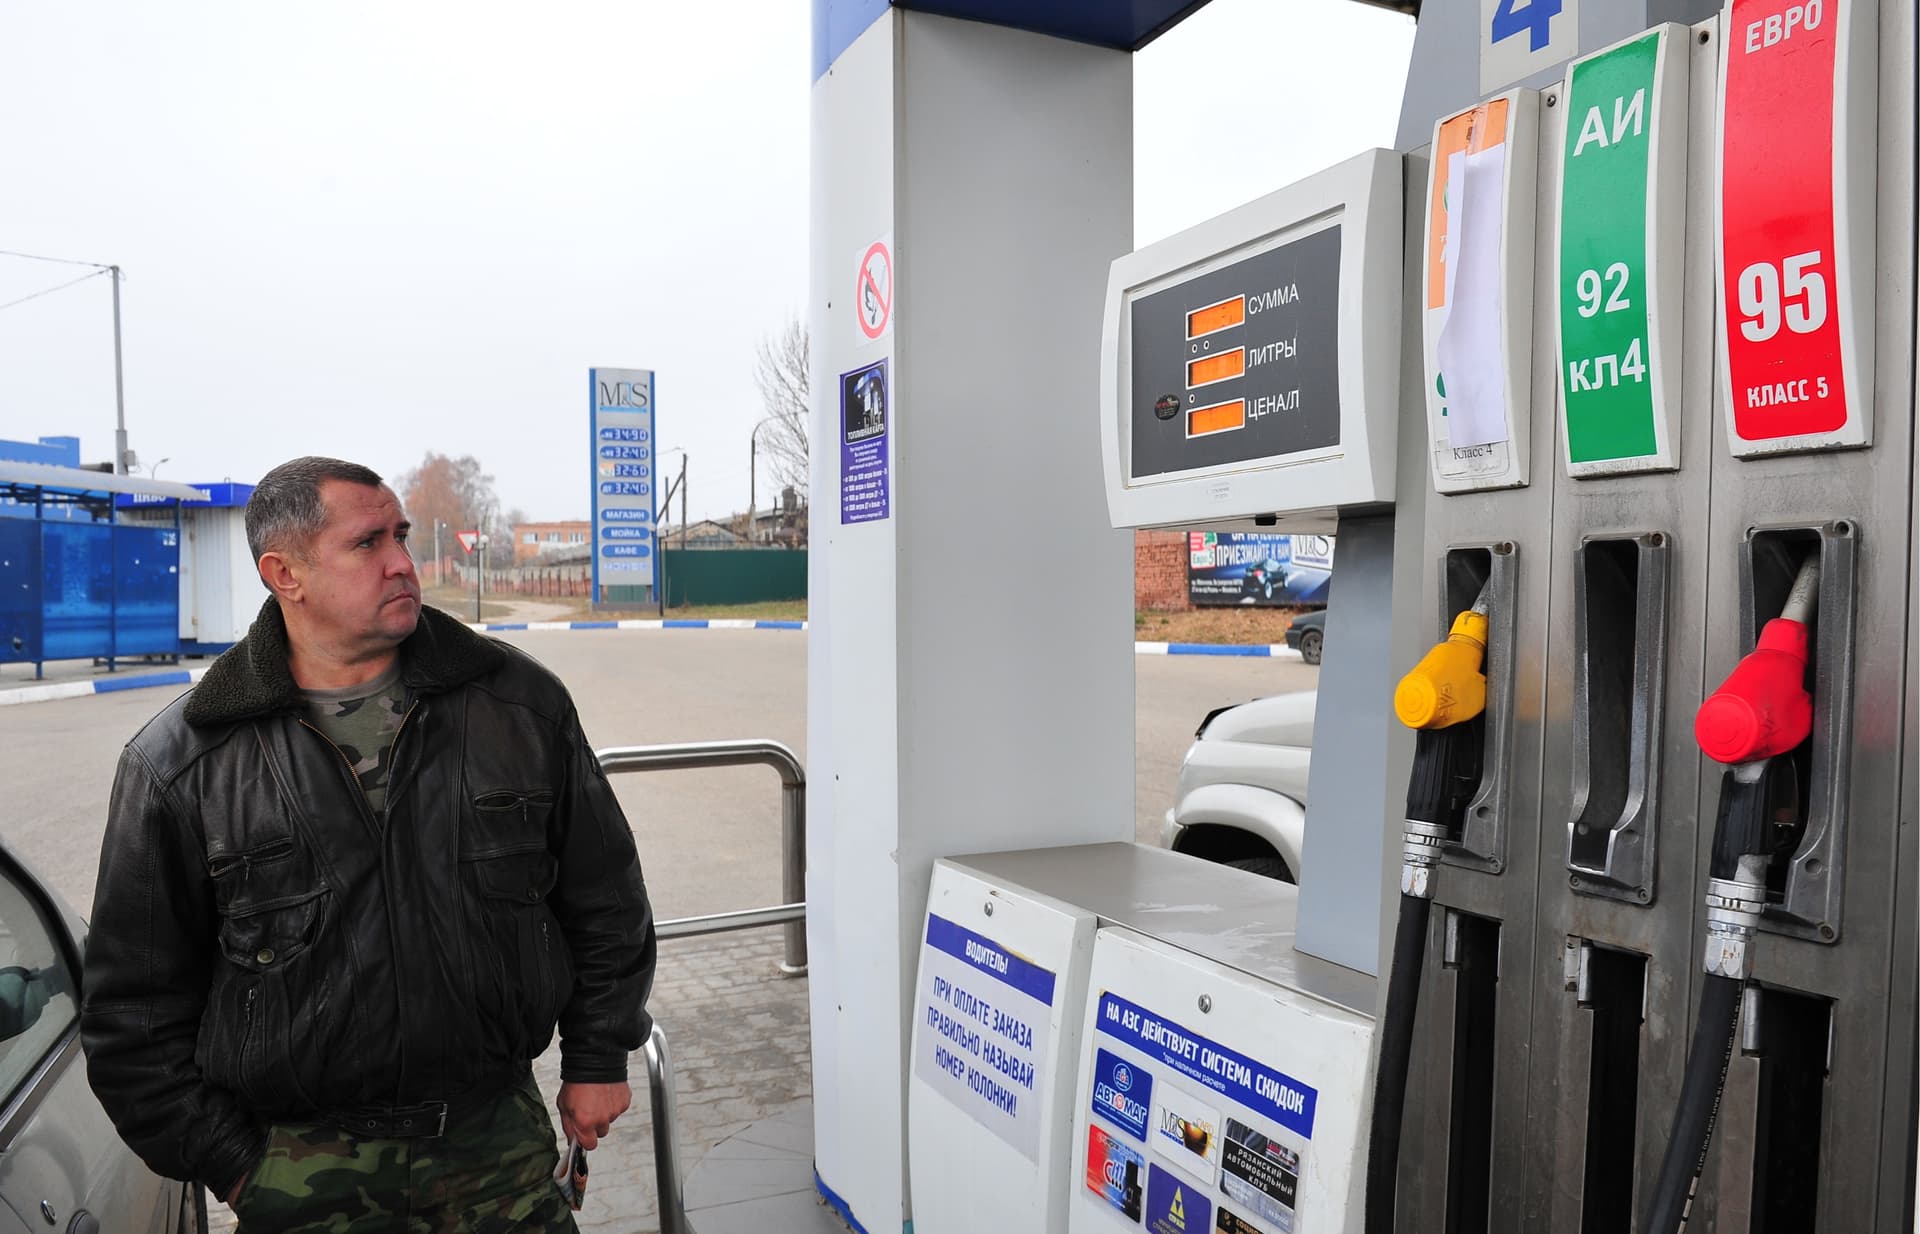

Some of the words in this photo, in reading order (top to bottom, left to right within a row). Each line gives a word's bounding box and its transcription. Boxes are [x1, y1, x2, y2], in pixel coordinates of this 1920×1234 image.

[1491, 0, 1562, 53] 4
[1745, 0, 1823, 54] ЕВРО
[1573, 88, 1645, 157] АИ
[1248, 283, 1299, 316] СУММА
[1576, 262, 1630, 319] 92
[1738, 250, 1828, 342] 95
[1248, 338, 1297, 369] ЛИТРЫ
[1569, 338, 1646, 393] КЛ4
[1248, 390, 1299, 421] ЦЕНА/Л
[1747, 379, 1809, 408] КЛАСС
[1817, 376, 1829, 399] 5
[1453, 447, 1483, 460] Класс
[1486, 443, 1492, 455] 4
[606, 511, 645, 520] МАГАЗИН
[611, 528, 641, 538] МОЙКА
[614, 546, 637, 555] КАФЕ
[1217, 541, 1269, 567] ПРИЕЗЖАЙТЕ
[965, 939, 1008, 975] ВОДИТЕЛЬ!
[934, 975, 951, 998] ПРИ
[954, 987, 990, 1026] ОПЛАТЕ
[993, 1009, 1032, 1051] ЗАКАЗА
[927, 1006, 980, 1057] ПРАВИЛЬНО
[982, 1039, 1034, 1090] НАЗЫВАЙ
[1106, 1002, 1120, 1023] НА
[1122, 1014, 1139, 1032] АЗС
[1141, 1022, 1199, 1062] ДЕЙСТВУЕТ
[1201, 1049, 1251, 1089] СИСТЕМА
[1255, 1074, 1305, 1115] СКИДОК
[935, 1044, 965, 1081] НОМЕР
[967, 1070, 1017, 1118] КОЛОНКИ!
[1094, 1081, 1147, 1125] АВТОМАГ
[1226, 1153, 1294, 1197] АВТОМОБИЛЬНЫЙ
[1238, 1148, 1282, 1180] РЯЗАНСКИЙ
[1248, 1175, 1269, 1192] КЛУБ
